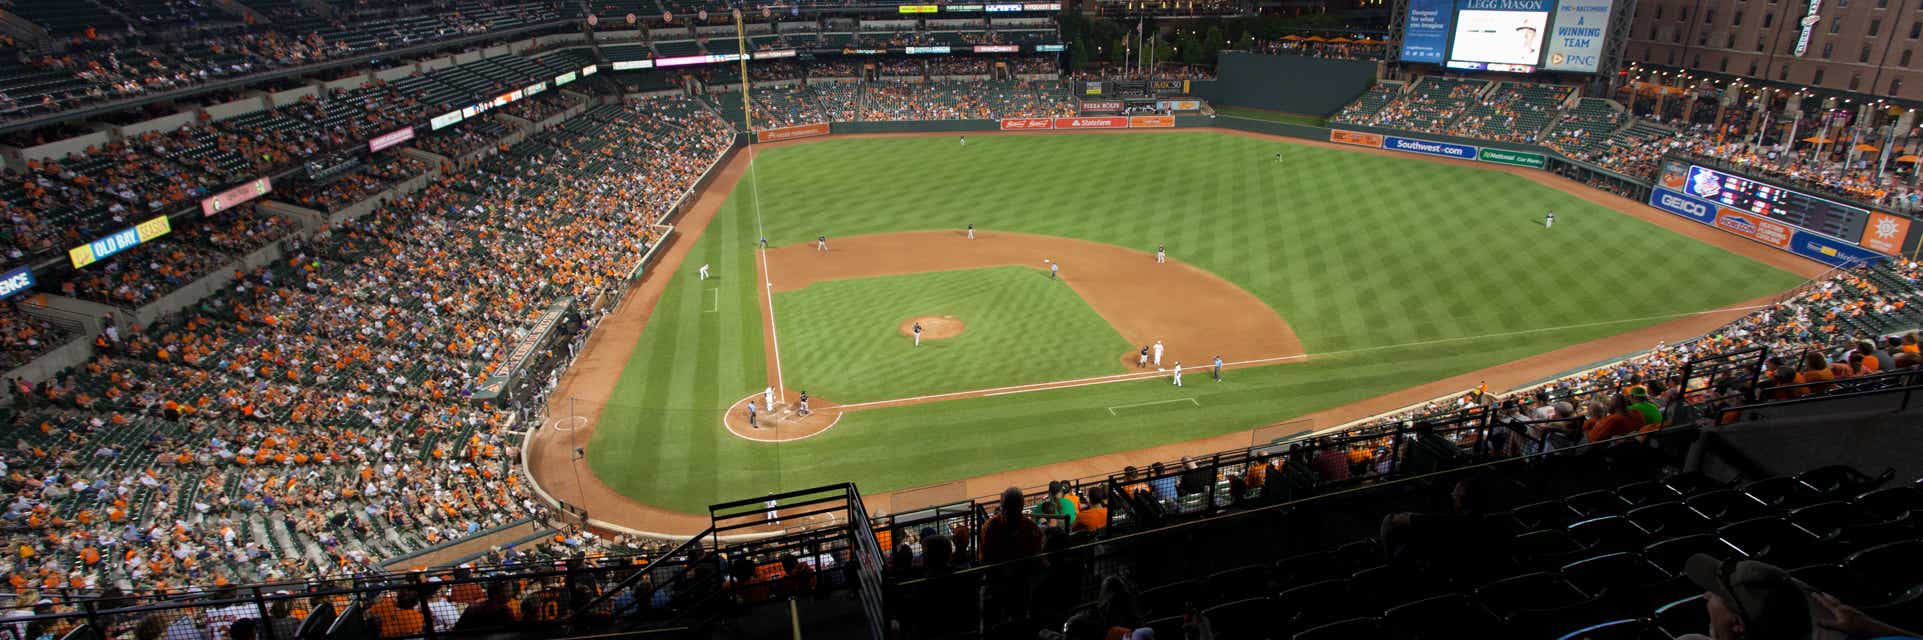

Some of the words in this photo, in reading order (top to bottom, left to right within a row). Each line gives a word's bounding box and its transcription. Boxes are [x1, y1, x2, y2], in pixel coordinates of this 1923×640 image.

[1500, 0, 1542, 10] MASON
[1577, 16, 1585, 26] A
[1558, 27, 1600, 37] WINNING
[1564, 38, 1590, 48] TEAM
[1566, 54, 1595, 66] PNC
[1661, 194, 1706, 216] GEICO
[94, 238, 117, 257] OLD
[116, 229, 137, 249] BAY
